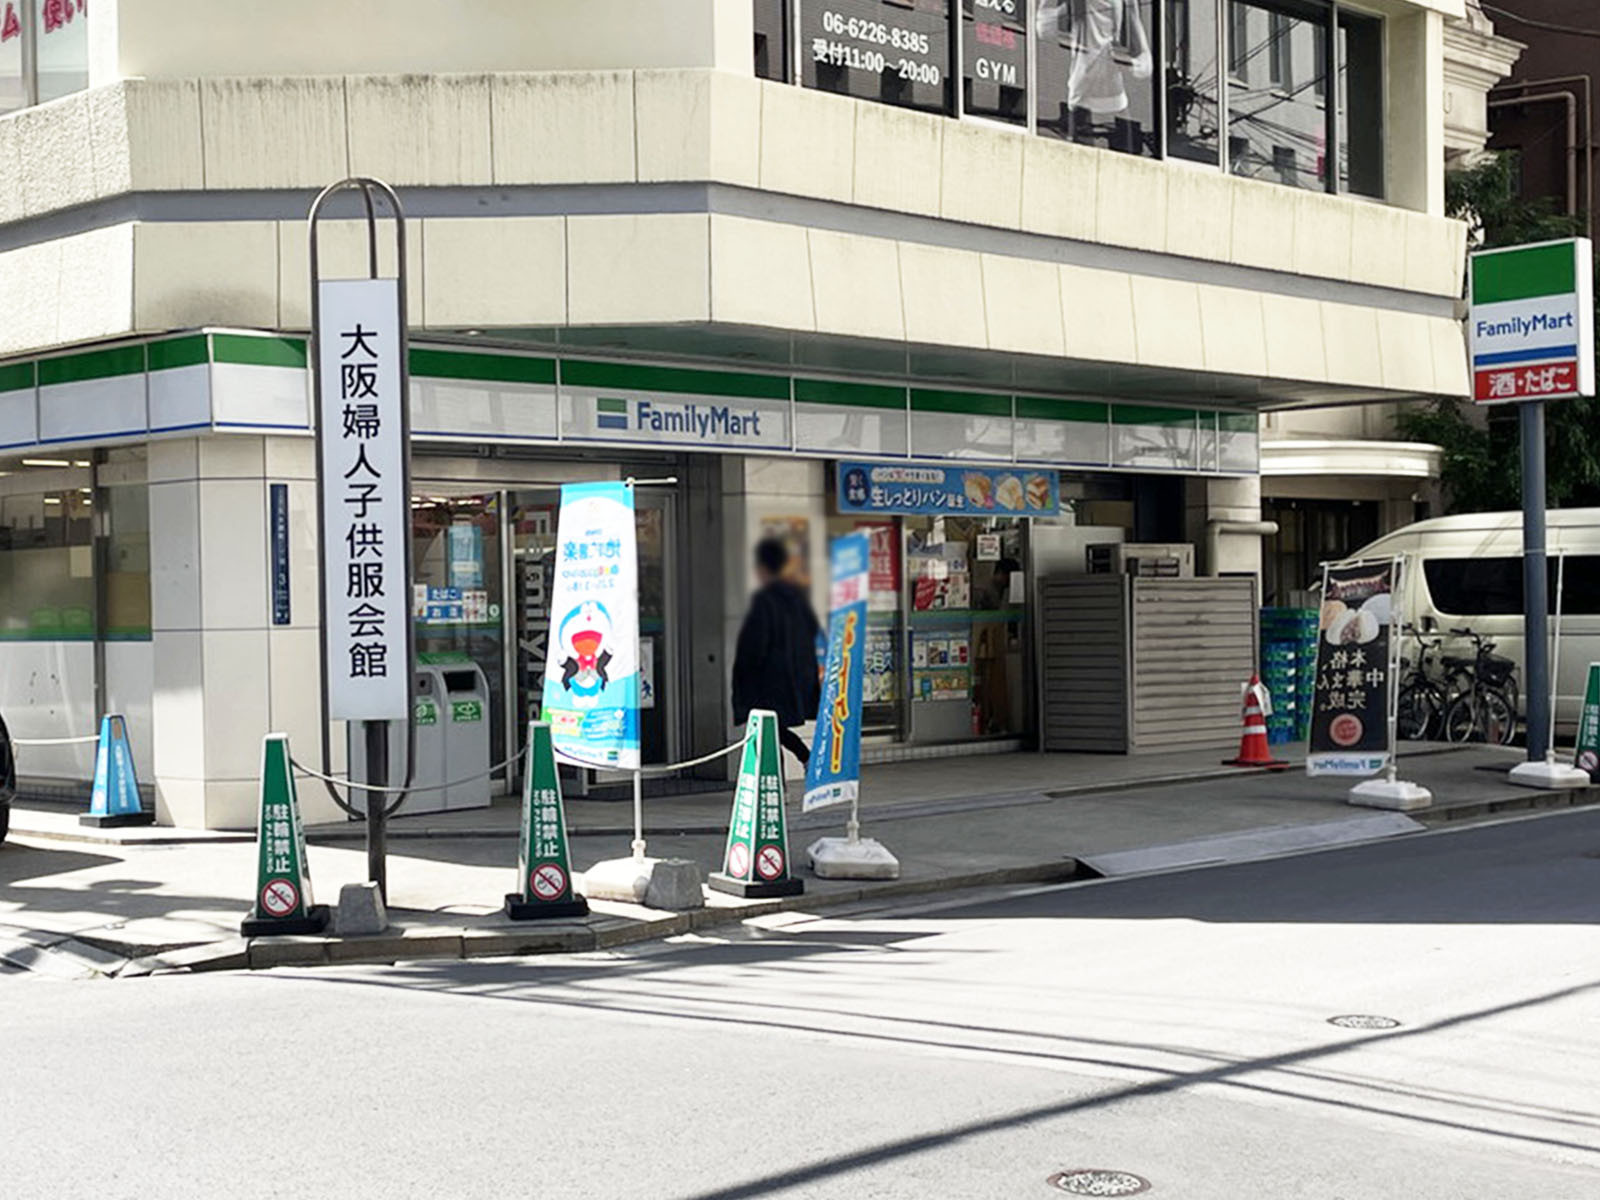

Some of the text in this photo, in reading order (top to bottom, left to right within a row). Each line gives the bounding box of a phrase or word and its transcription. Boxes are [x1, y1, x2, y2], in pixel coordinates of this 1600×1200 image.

[823, 10, 929, 55] 06-6226-8385
[975, 57, 1017, 85] GYM
[1477, 312, 1574, 338] FamilyMart
[1489, 366, 1571, 397] 酒・たばこ
[637, 401, 761, 438] FamilyMart
[340, 323, 388, 680] 大阪婦人子供服会館
